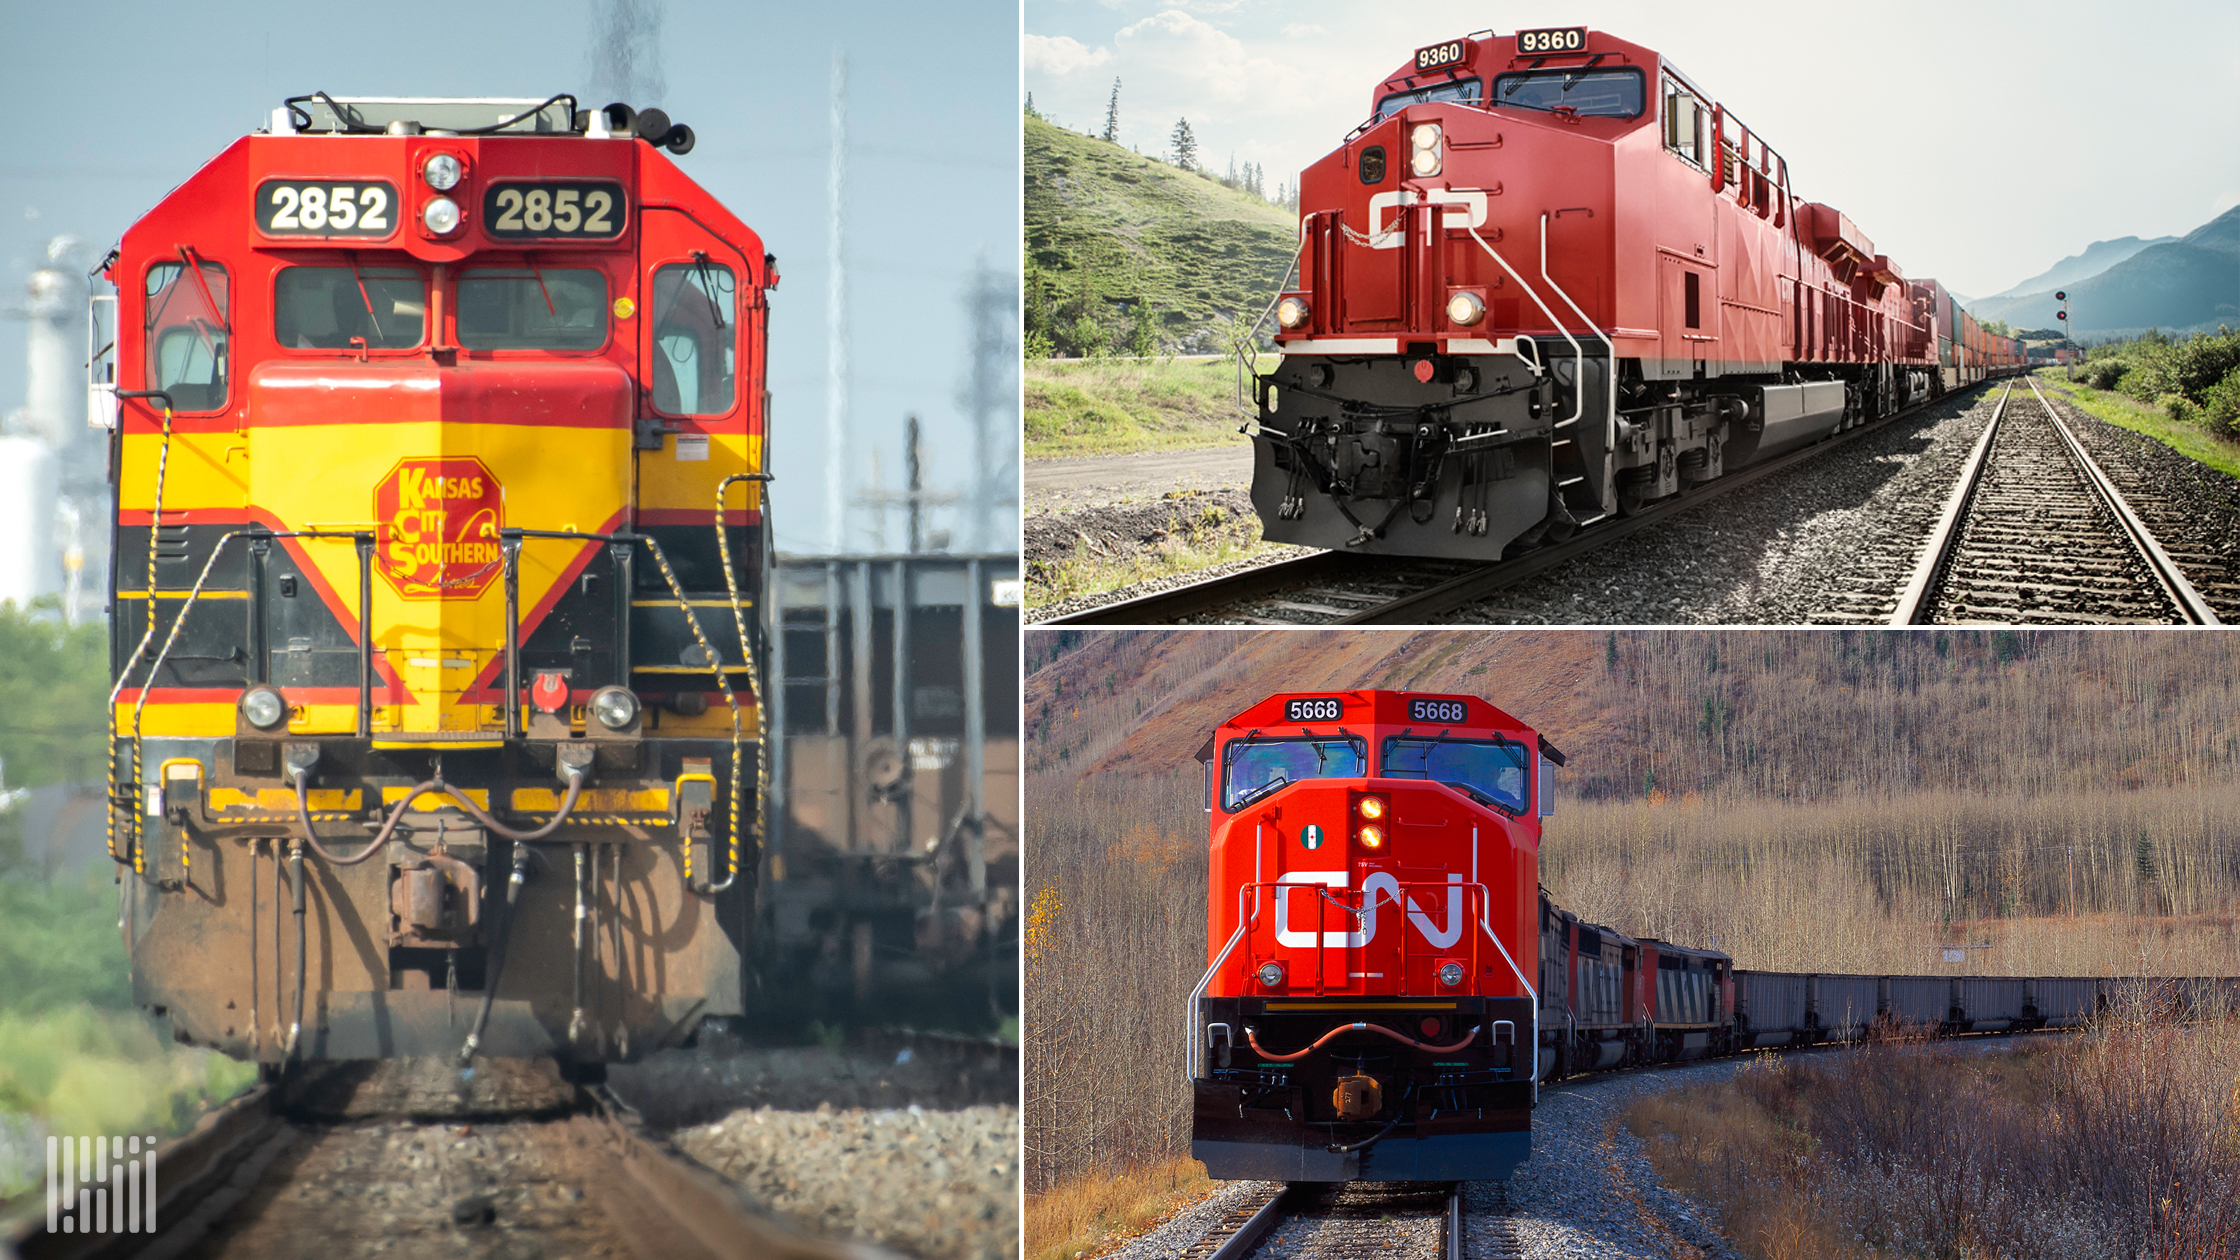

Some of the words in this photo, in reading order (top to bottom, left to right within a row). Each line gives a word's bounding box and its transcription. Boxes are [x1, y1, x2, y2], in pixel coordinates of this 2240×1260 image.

[1419, 43, 1460, 68] 9360
[1523, 30, 1579, 51] 9360
[270, 186, 387, 230] 2852
[495, 189, 612, 232] 2852
[1369, 187, 1488, 249] CP
[391, 510, 448, 544] CITY
[388, 540, 498, 579] SOUTHERN
[1290, 701, 1338, 719] 5668
[1414, 701, 1463, 721] 5668
[1275, 871, 1463, 949] CN
